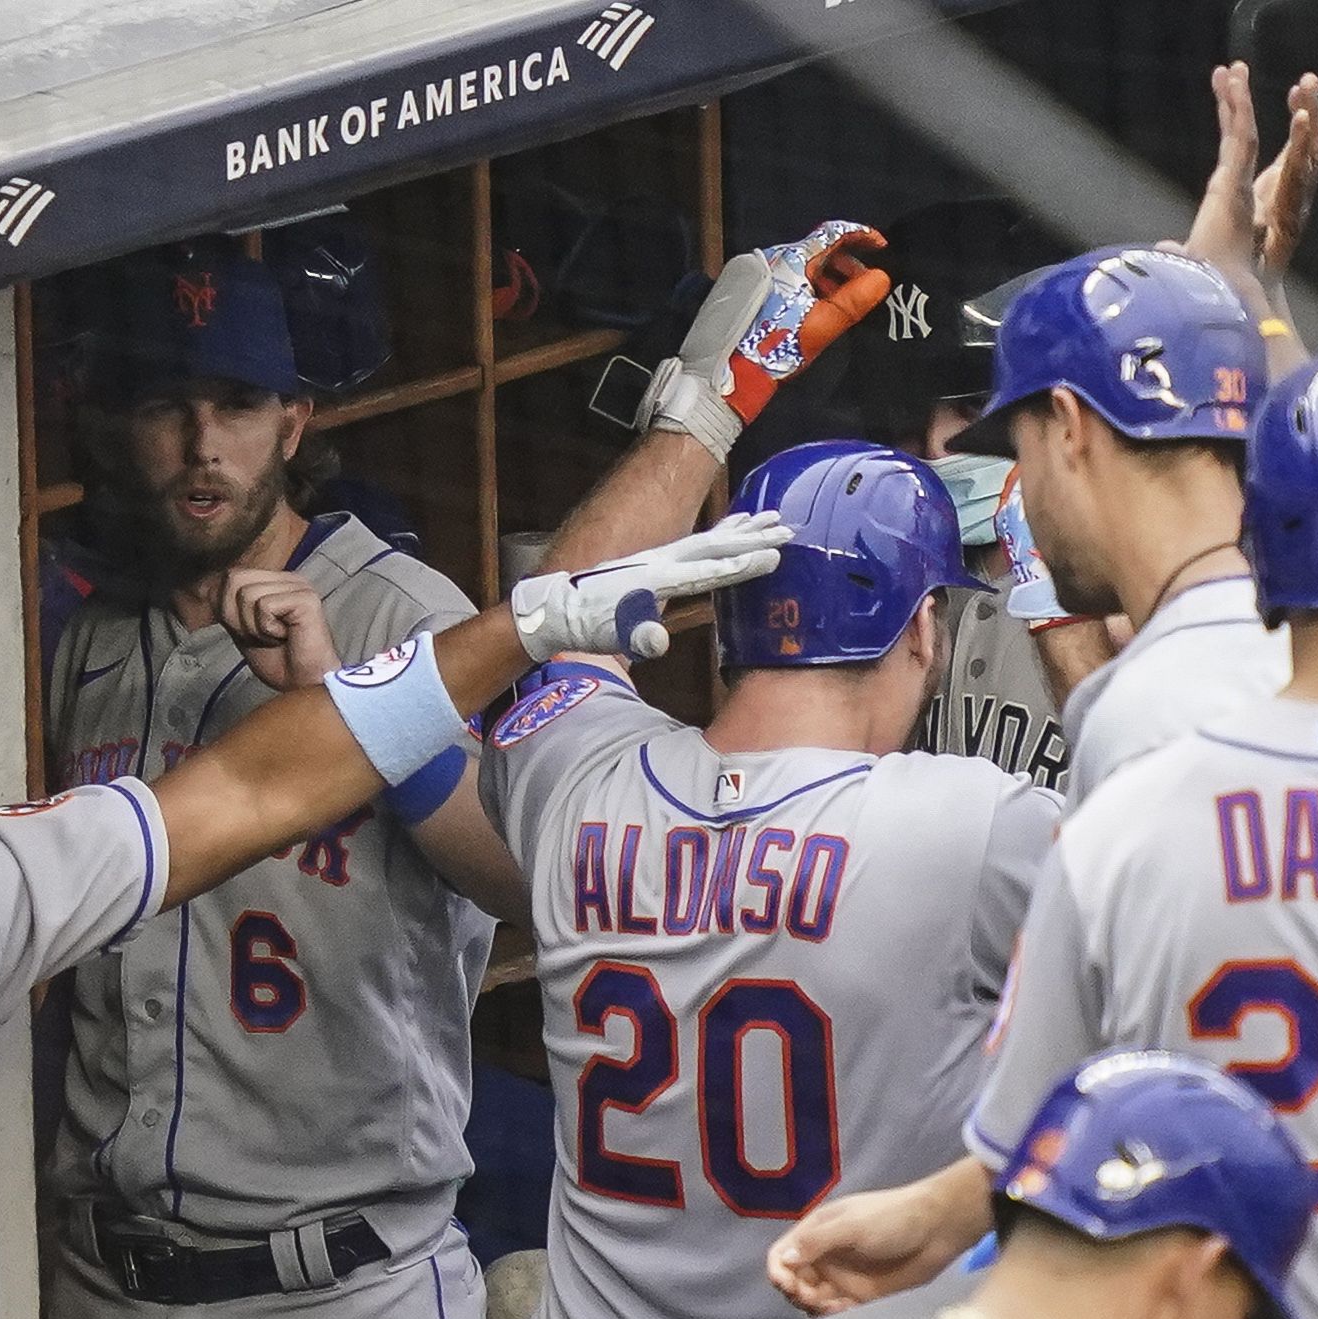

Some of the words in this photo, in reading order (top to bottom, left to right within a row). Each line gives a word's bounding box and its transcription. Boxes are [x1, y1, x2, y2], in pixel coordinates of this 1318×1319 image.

[225, 115, 329, 182] BANK
[339, 97, 388, 148] OF
[397, 46, 570, 131] AMERICA
[885, 283, 932, 342] NY
[767, 598, 800, 628] 20
[962, 693, 1070, 792] YOR
[574, 821, 850, 944] ALONSO
[229, 909, 307, 1034] 6
[572, 960, 842, 1220] 20
